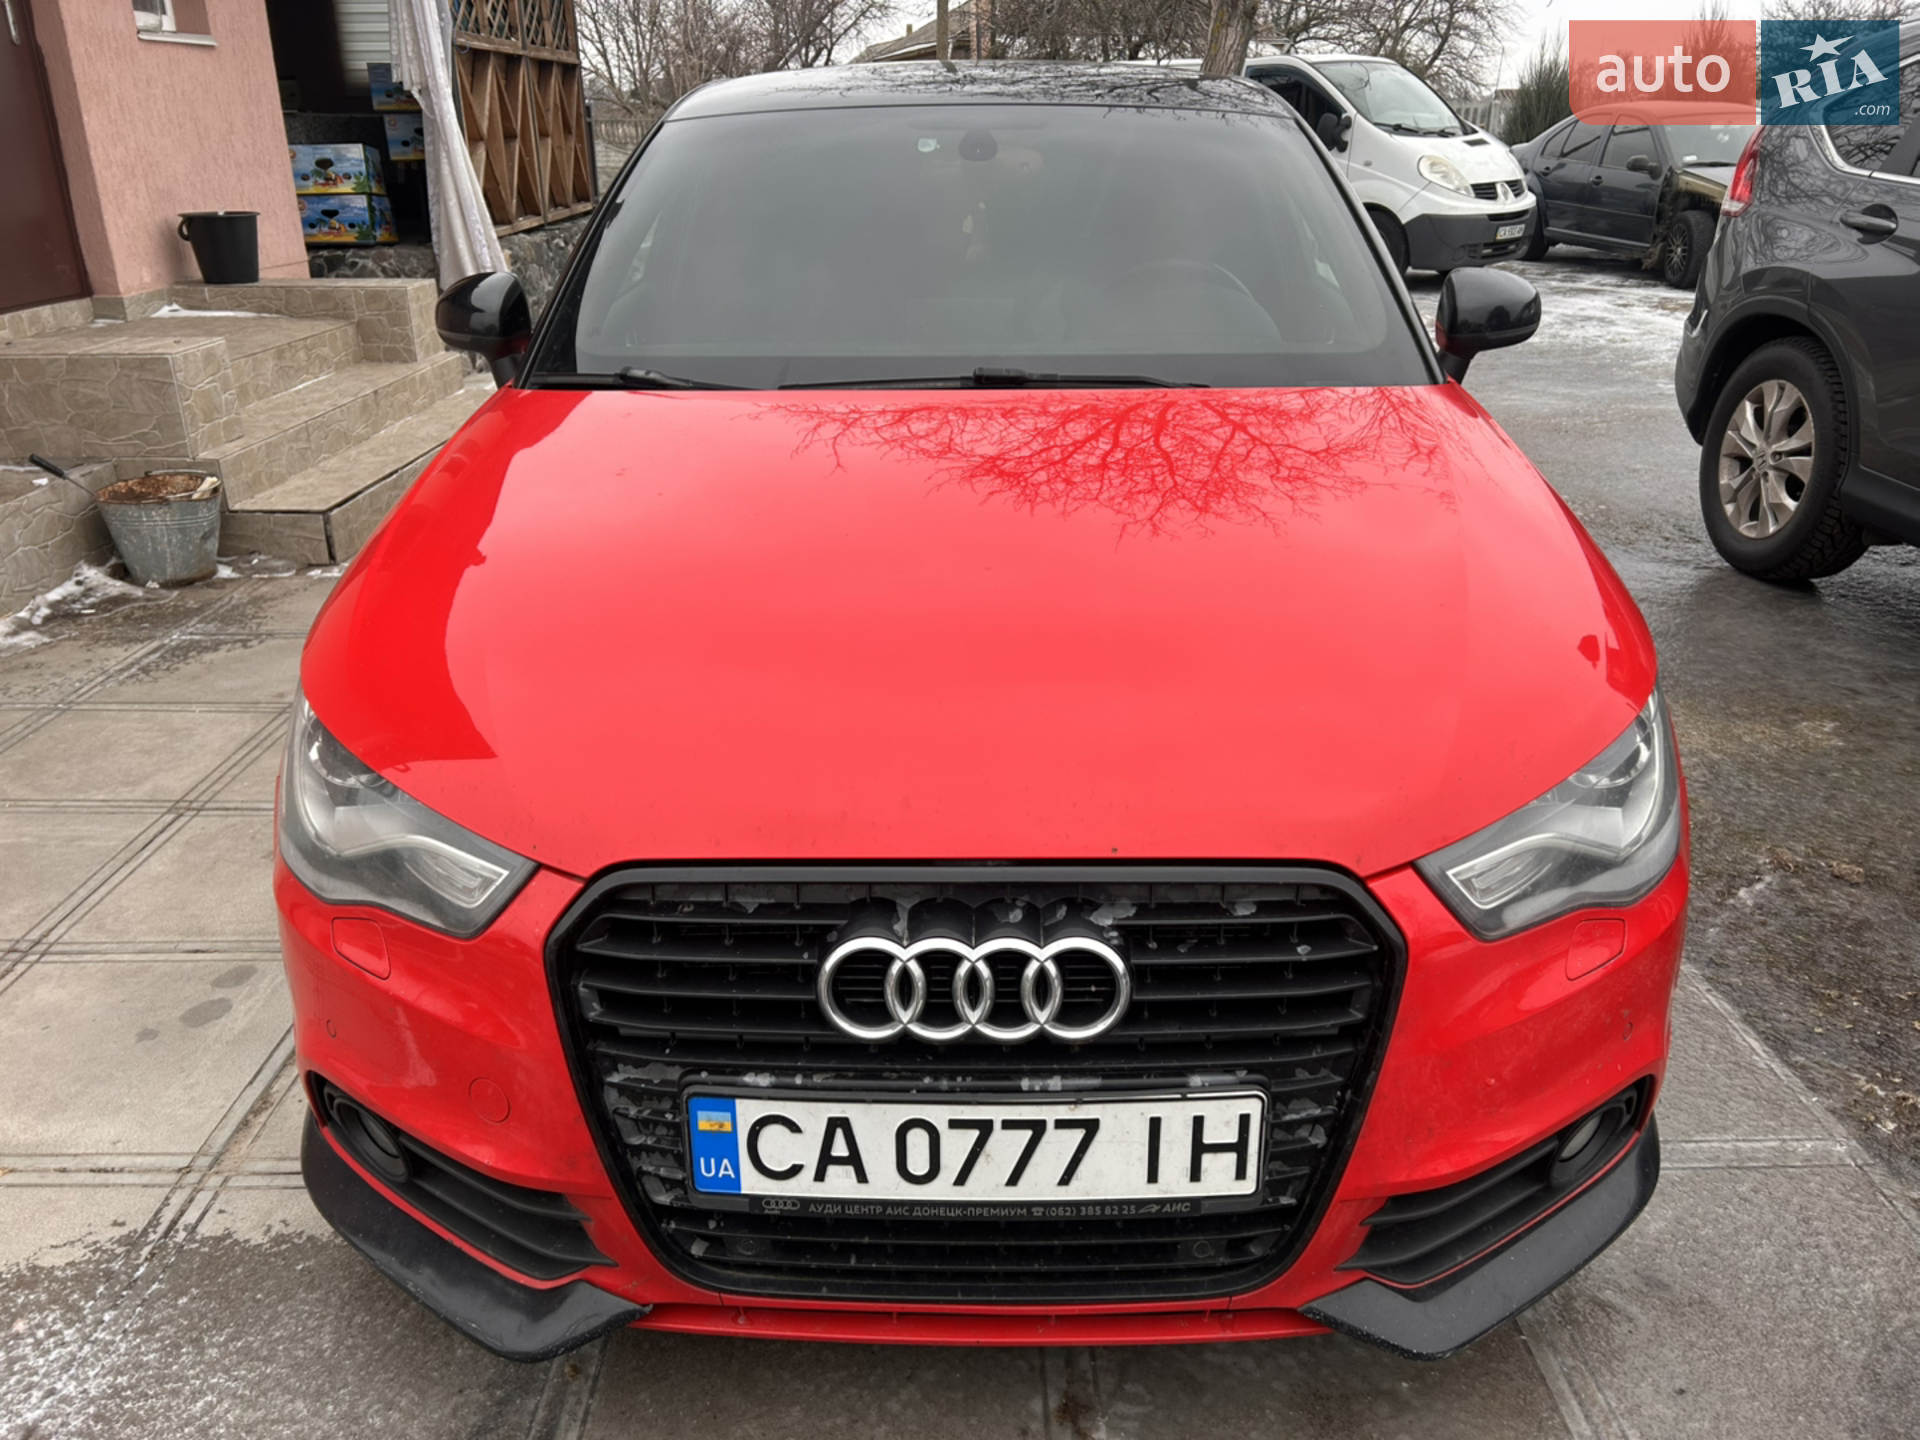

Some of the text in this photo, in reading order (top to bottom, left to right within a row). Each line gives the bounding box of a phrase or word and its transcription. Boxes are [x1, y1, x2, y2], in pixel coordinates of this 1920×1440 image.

[746, 1112, 1252, 1187] CA 0777 IH
[700, 1157, 735, 1179] UA
[808, 1203, 843, 1214] АУДИ
[845, 1204, 883, 1215] ЦЕНТР
[885, 1205, 909, 1216] АИС
[1162, 1202, 1191, 1213] АИС
